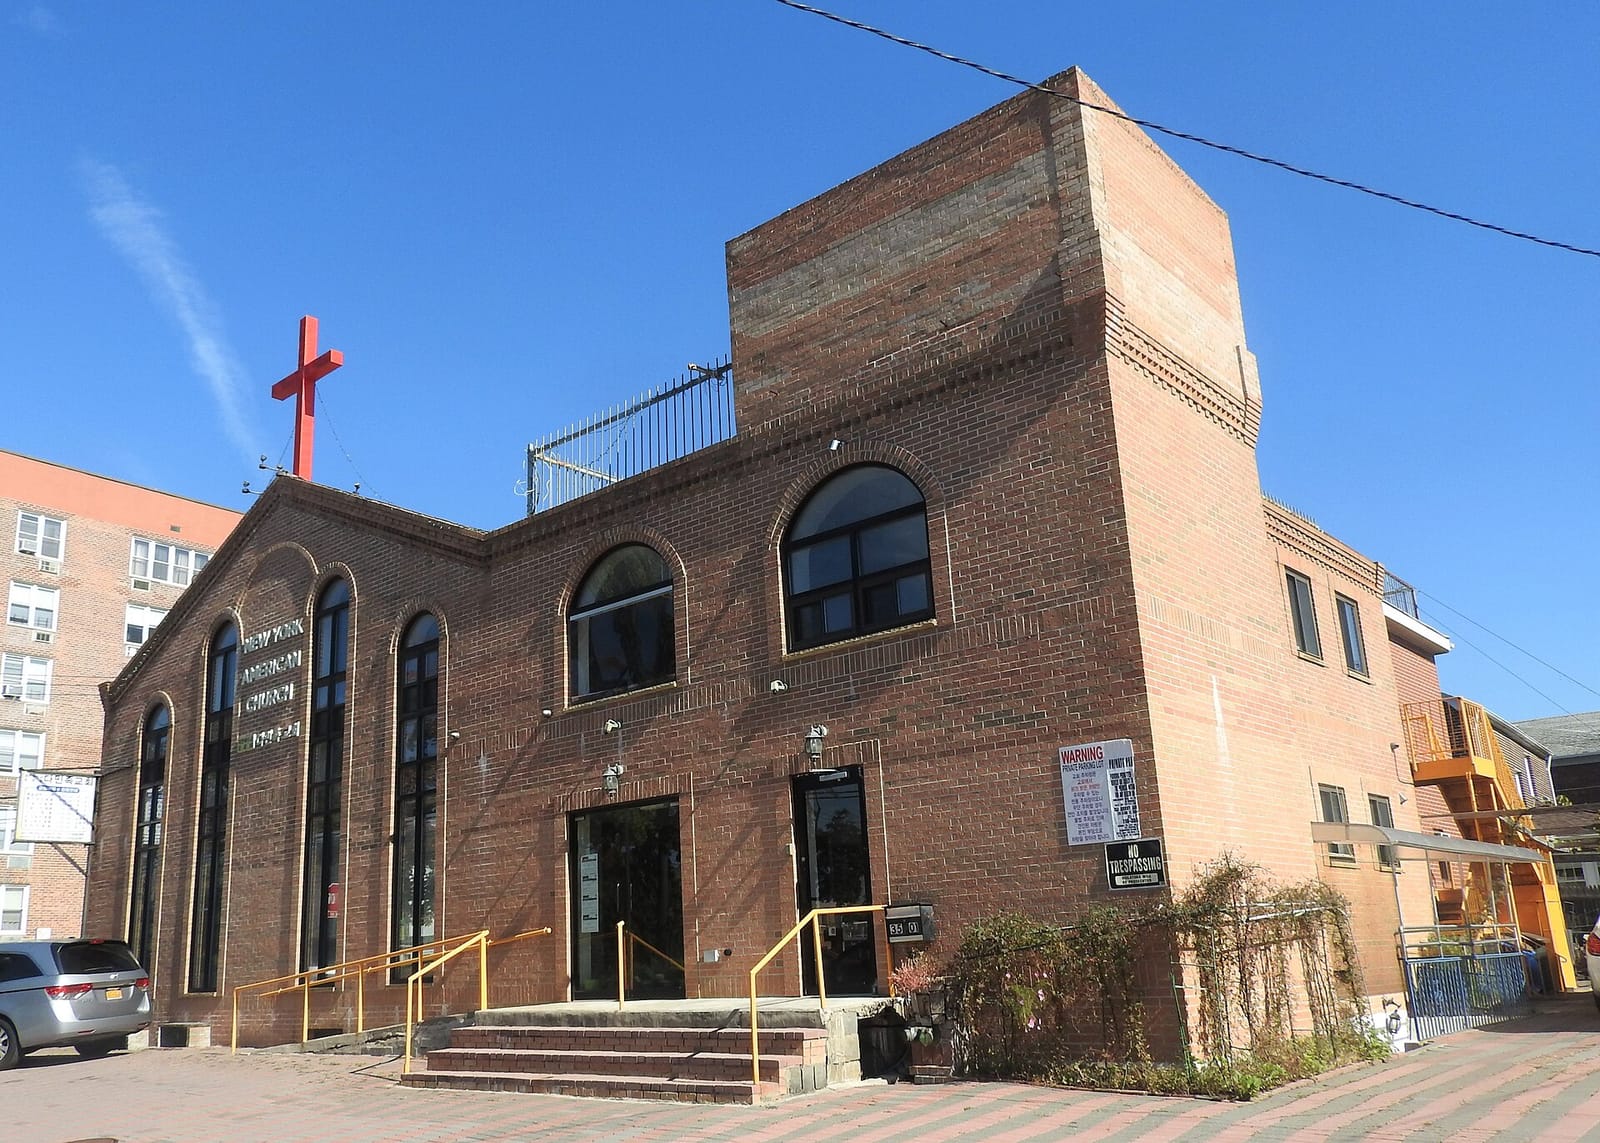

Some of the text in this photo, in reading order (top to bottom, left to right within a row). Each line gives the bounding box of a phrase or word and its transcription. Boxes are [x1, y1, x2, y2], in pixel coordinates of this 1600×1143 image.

[243, 618, 304, 654] NEW YORK
[240, 650, 302, 685] AMERICAN
[246, 682, 294, 711] CHURCH
[1061, 746, 1104, 764] WARNING
[1127, 844, 1139, 858] NO
[1109, 856, 1162, 874] TRESPASSING
[890, 923, 903, 935] 35
